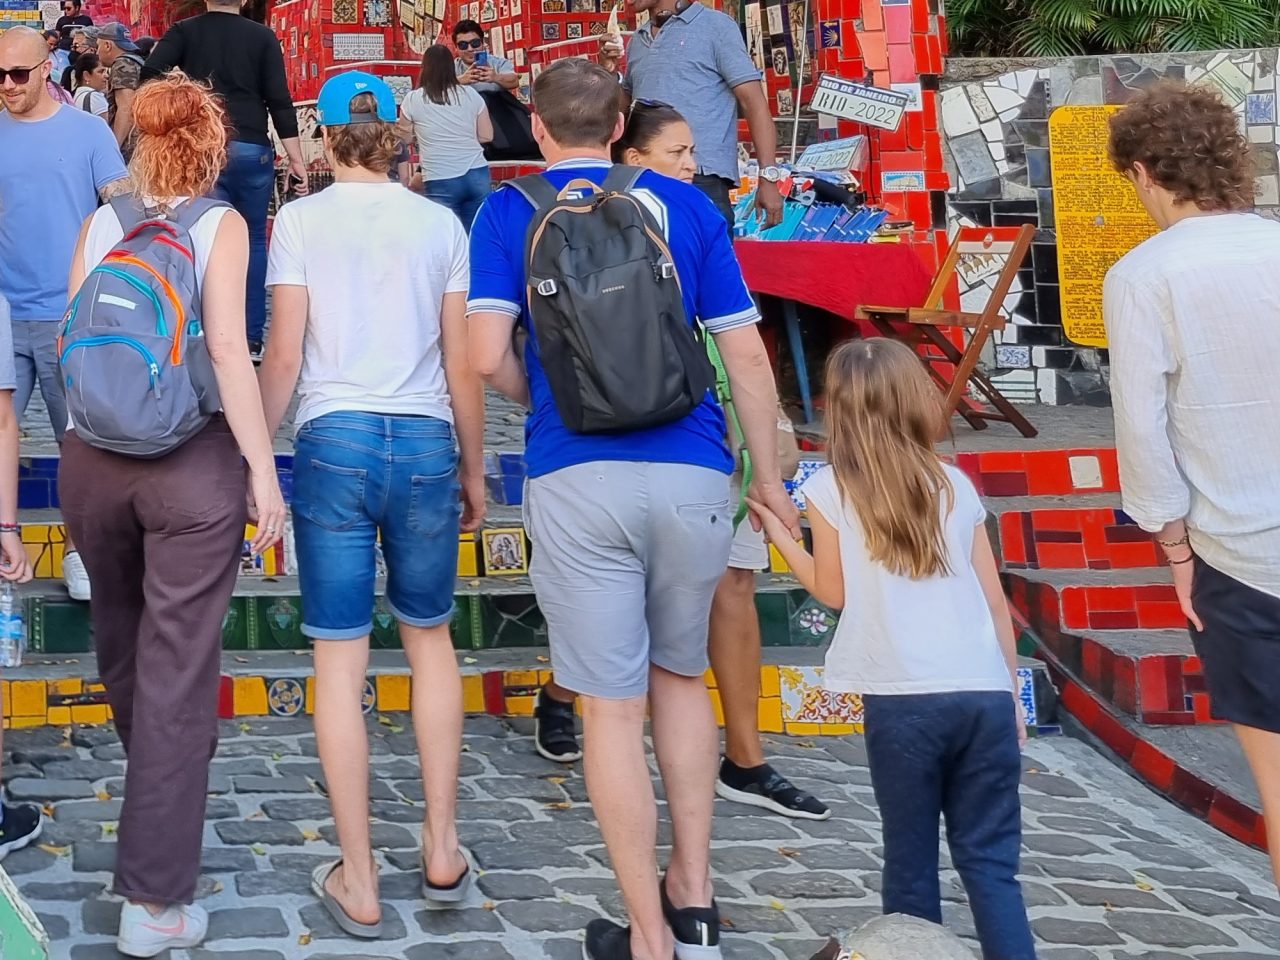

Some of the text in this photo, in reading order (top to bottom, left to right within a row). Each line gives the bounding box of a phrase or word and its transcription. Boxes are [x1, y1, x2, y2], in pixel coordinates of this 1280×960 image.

[820, 80, 897, 104] RIO DE JANEIRO
